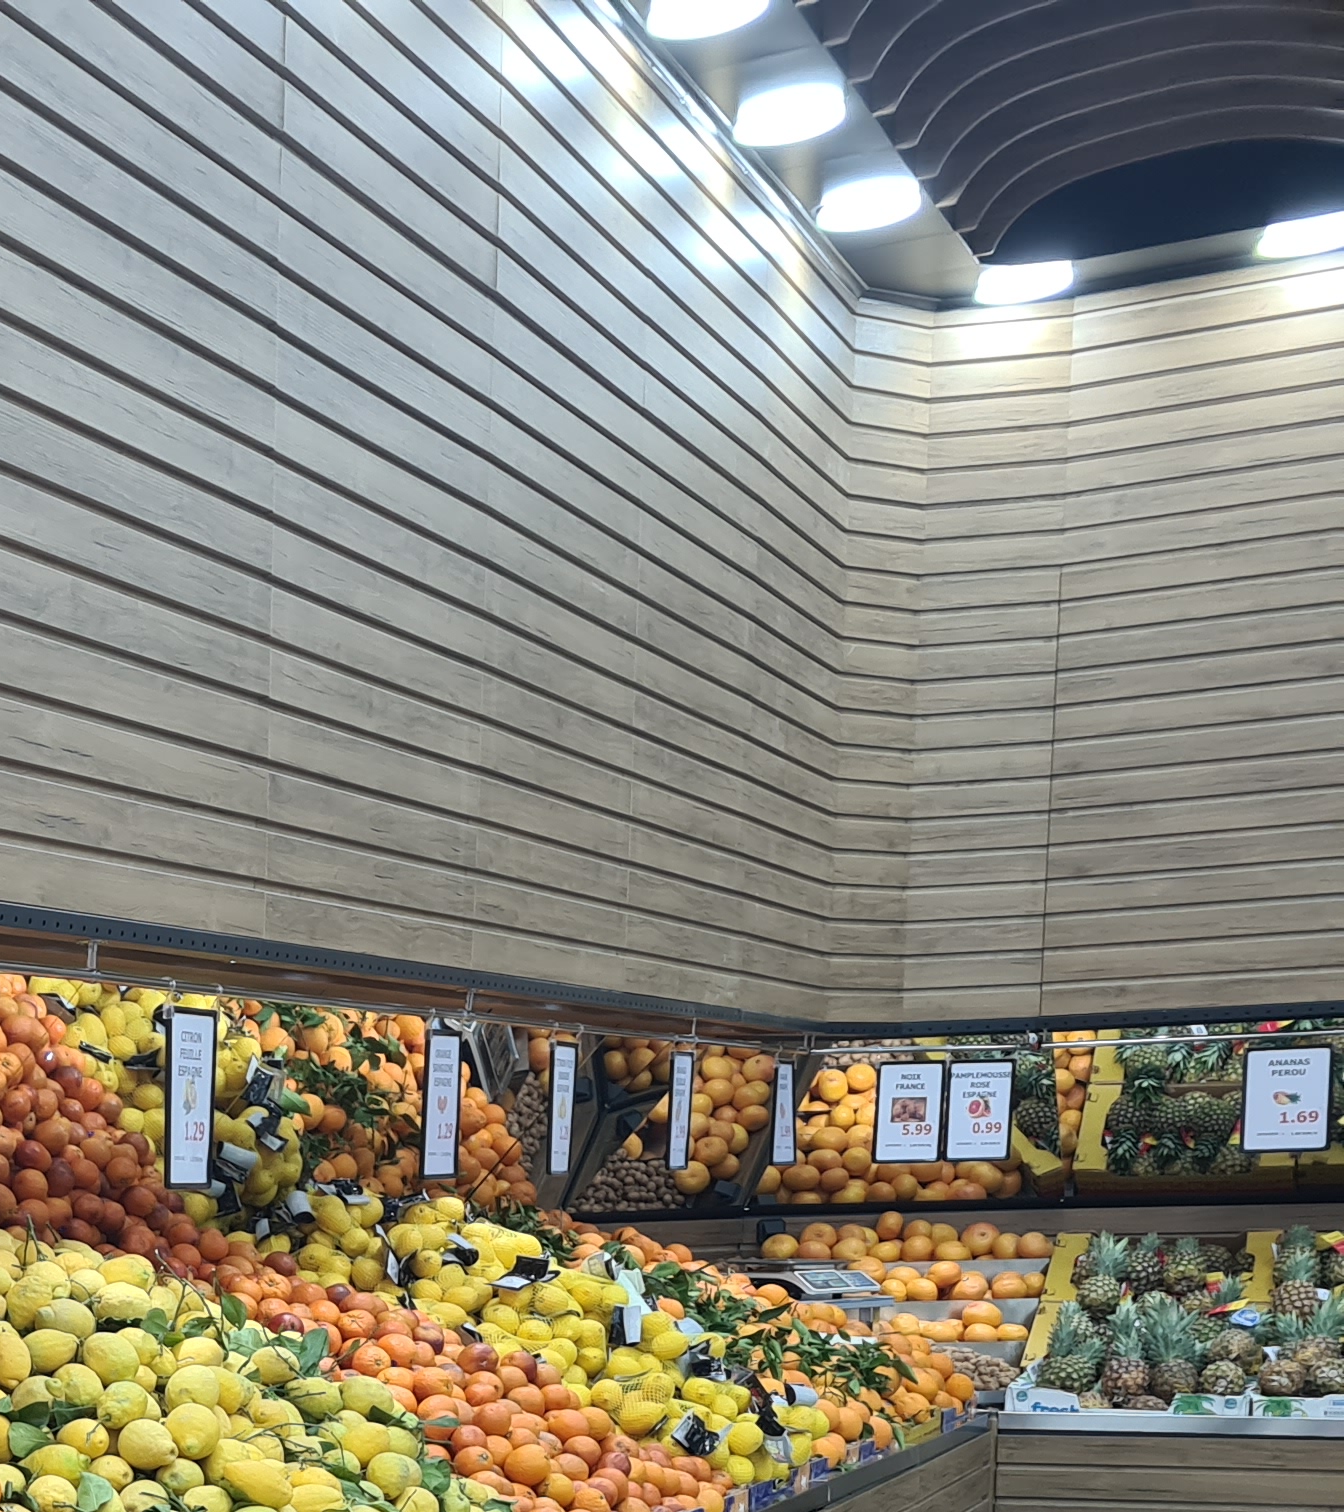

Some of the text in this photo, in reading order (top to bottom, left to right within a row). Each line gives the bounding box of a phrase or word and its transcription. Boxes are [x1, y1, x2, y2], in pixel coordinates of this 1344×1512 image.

[1268, 1057, 1311, 1067] ANANAS
[1271, 1068, 1307, 1077] PEROU
[895, 1082, 926, 1090] FRANCE
[1279, 1110, 1319, 1124] 1.69
[184, 1121, 205, 1142] 1.29
[901, 1123, 932, 1136] 5.99
[972, 1121, 1002, 1134] 0.99
